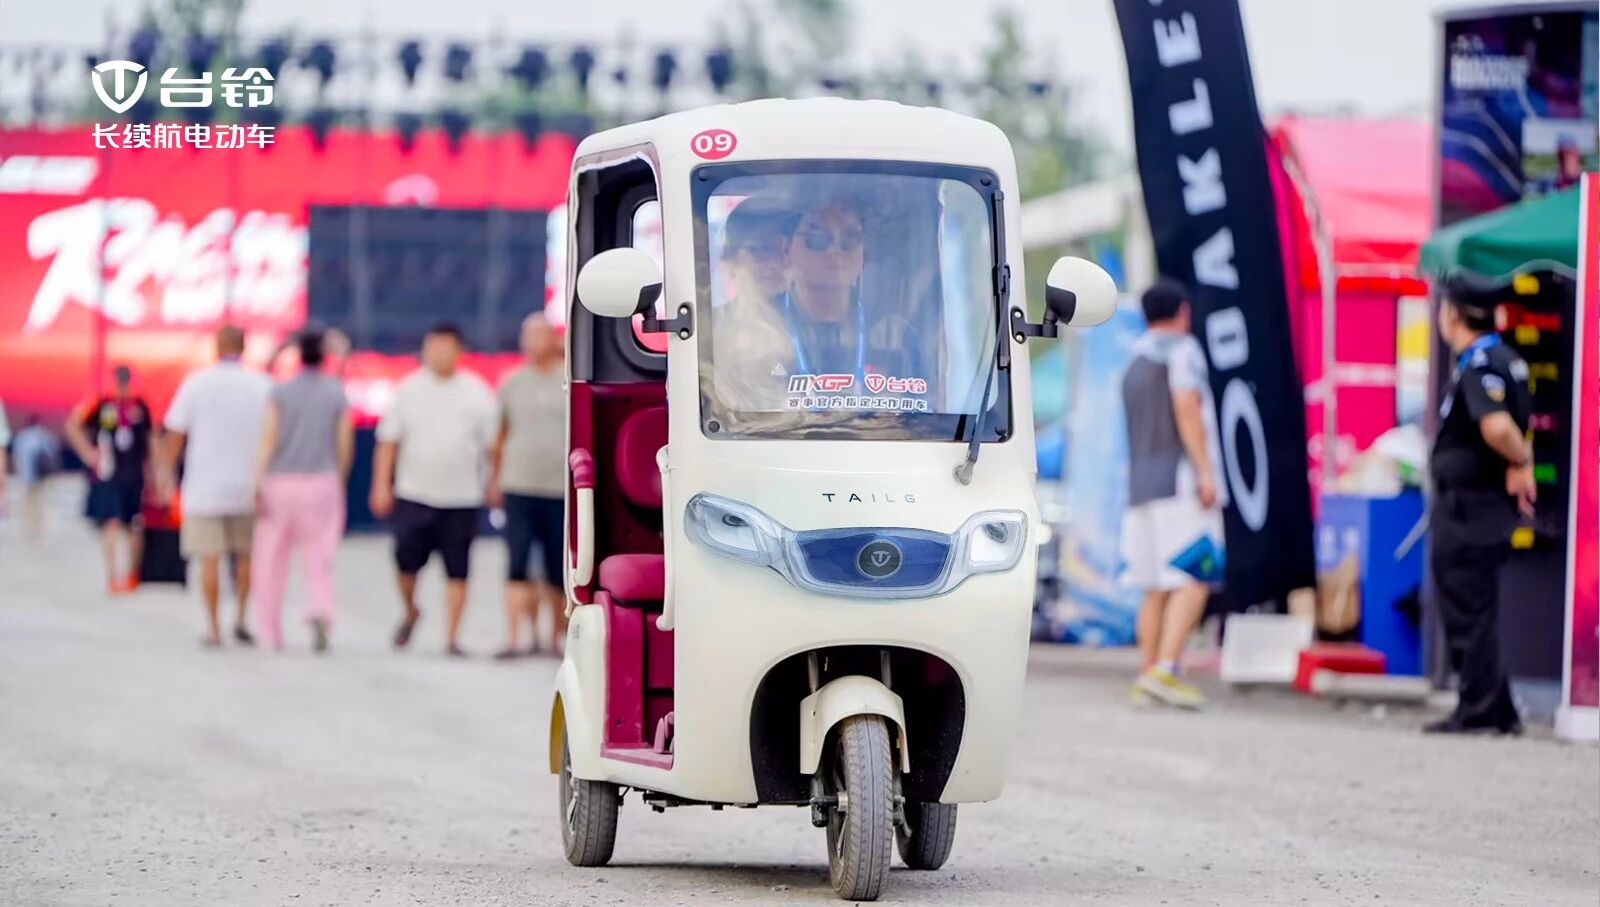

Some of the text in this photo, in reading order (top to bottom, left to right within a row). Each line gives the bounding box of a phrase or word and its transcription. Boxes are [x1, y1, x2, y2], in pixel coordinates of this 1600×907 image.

[695, 133, 732, 153] 09
[1149, 0, 1249, 371] OAKLE
[789, 375, 853, 392] MXGP
[822, 493, 916, 503] TAILG
